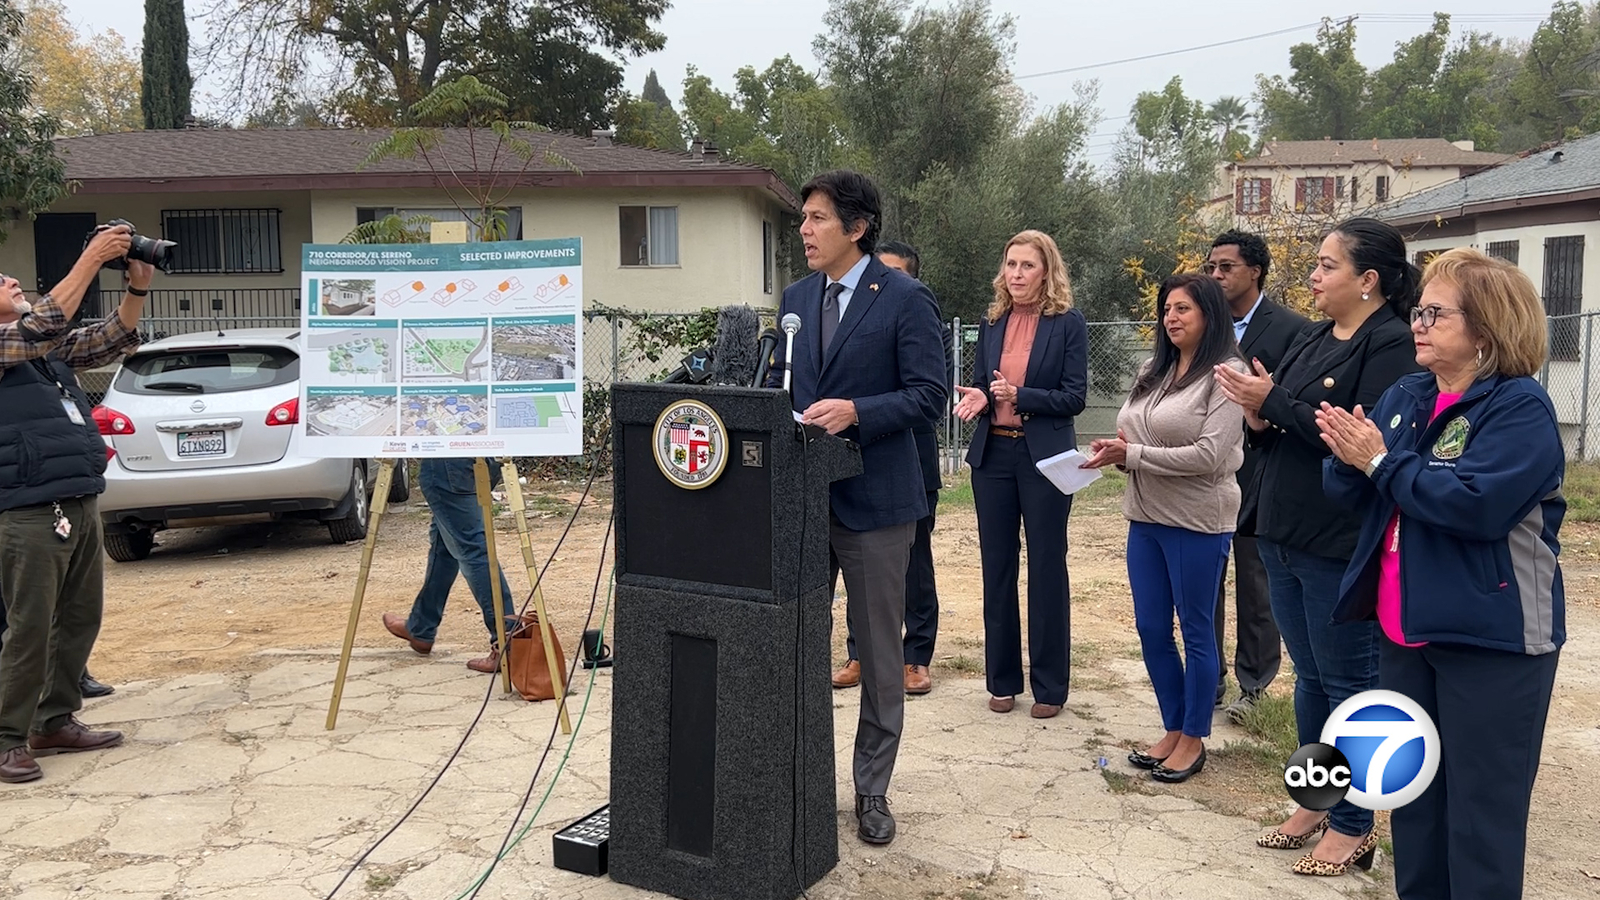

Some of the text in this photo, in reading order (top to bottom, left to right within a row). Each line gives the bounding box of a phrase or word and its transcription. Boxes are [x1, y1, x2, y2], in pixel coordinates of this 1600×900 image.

[325, 251, 380, 260] CORRIDOR/EL
[460, 248, 575, 261] SELECTED IMPROVEMENTS
[309, 258, 376, 266] NEIGHBORHOOD
[407, 257, 439, 265] PROJECT
[662, 415, 674, 429] CITY
[696, 410, 717, 433] ANGELES
[181, 439, 222, 452] 6TXN899
[671, 467, 695, 480] FOUNDED
